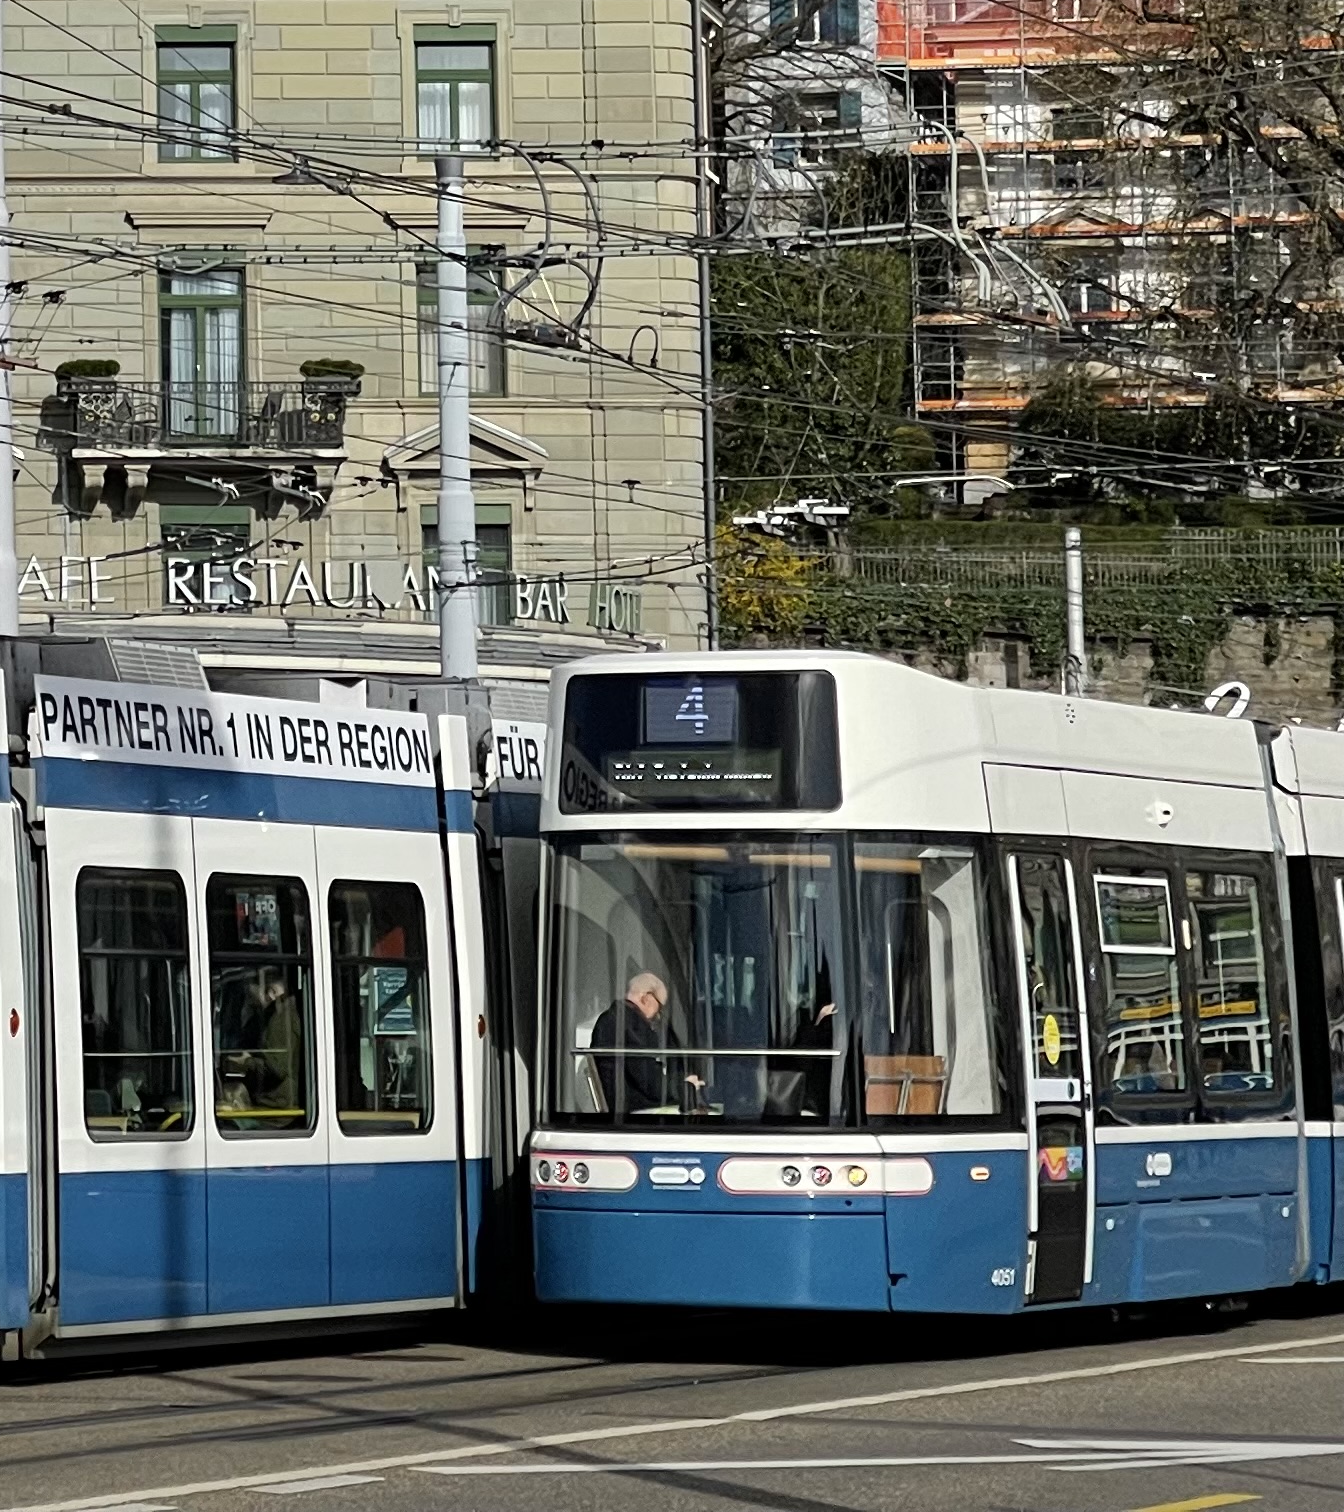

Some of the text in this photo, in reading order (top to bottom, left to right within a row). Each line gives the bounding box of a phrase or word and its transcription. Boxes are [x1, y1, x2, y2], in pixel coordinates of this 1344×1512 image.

[516, 574, 570, 623] BAR
[40, 693, 171, 752] PARTNER
[246, 712, 274, 761] IN
[280, 716, 332, 767] DER
[339, 722, 430, 774] REGION
[675, 686, 709, 735] 4
[497, 725, 542, 781] FÜR
